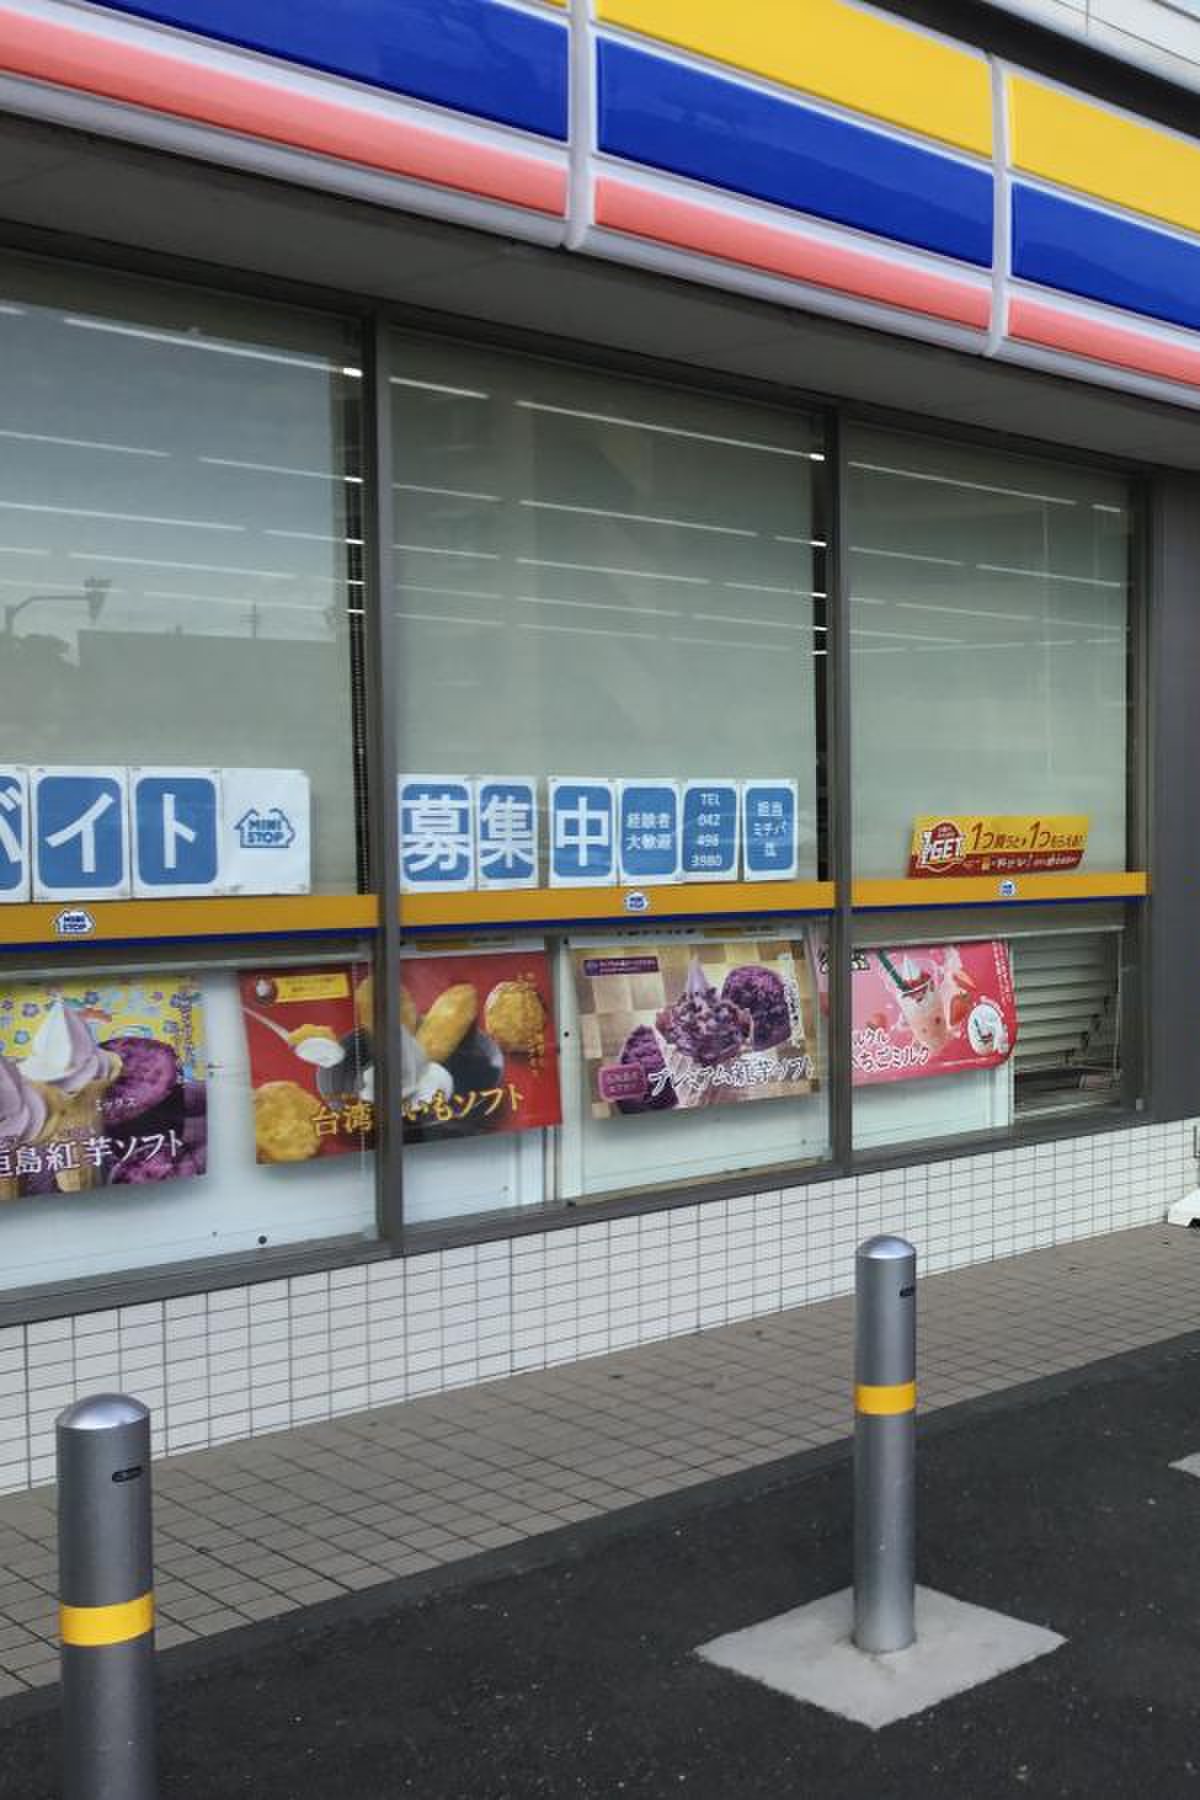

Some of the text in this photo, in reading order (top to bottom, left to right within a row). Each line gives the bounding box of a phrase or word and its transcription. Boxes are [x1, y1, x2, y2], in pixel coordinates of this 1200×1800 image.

[248, 831, 285, 844] STOP
[402, 794, 609, 872] 募集中
